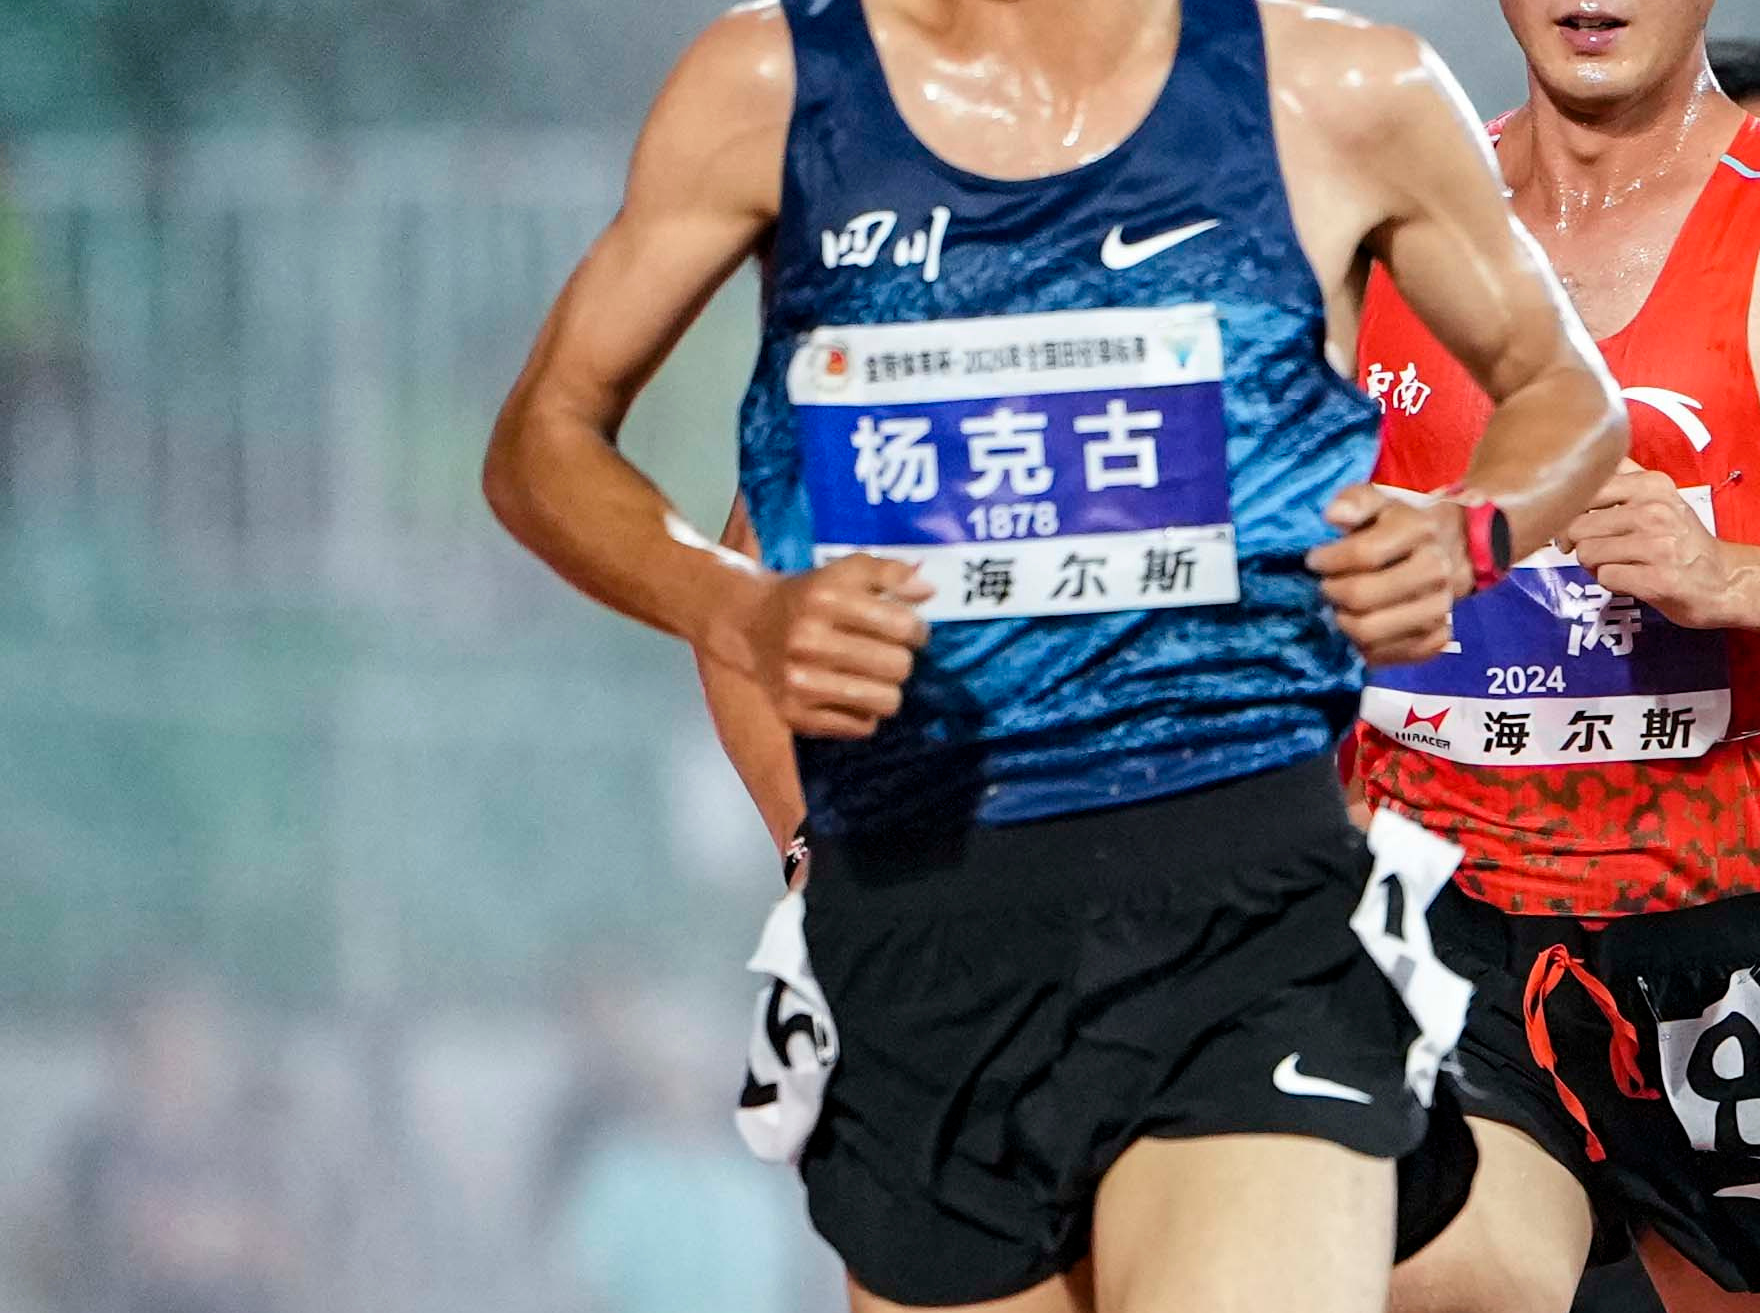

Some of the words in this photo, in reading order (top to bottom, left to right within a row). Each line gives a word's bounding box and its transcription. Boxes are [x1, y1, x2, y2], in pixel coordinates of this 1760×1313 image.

[820, 205, 952, 283] 四川
[850, 399, 1164, 505] 杨克古
[966, 500, 1060, 541] 1878
[963, 547, 1198, 605] 海尔斯
[1485, 665, 1567, 695] 2024
[1483, 706, 1697, 756] 海尔斯
